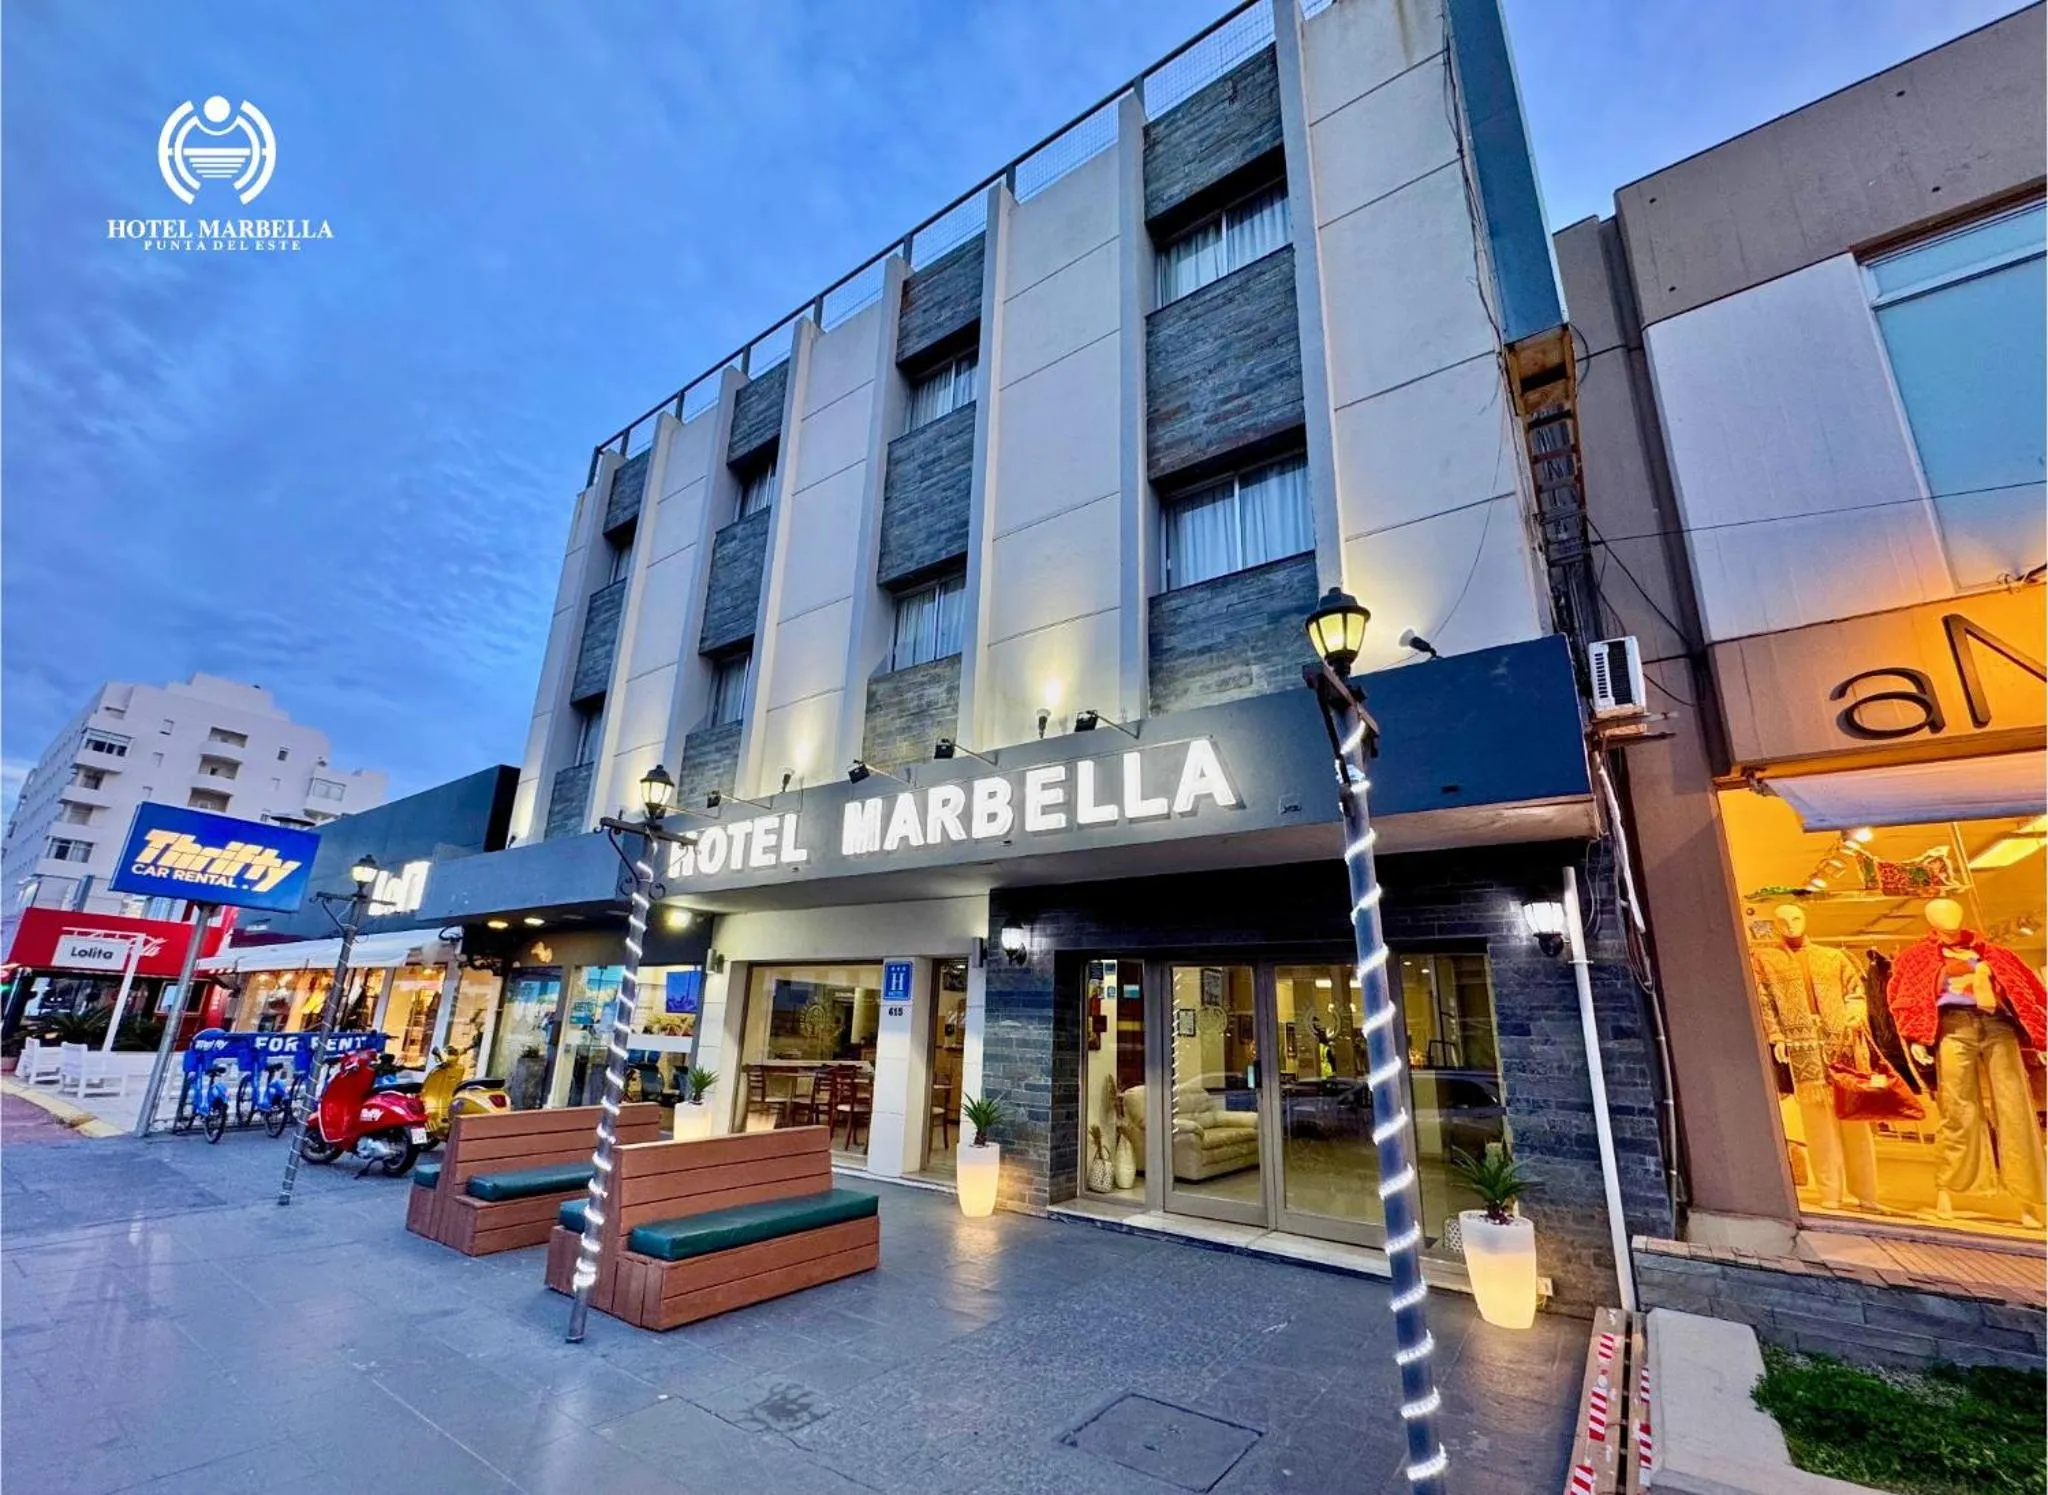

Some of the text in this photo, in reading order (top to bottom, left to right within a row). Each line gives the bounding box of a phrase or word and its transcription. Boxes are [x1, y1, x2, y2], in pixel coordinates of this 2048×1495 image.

[668, 738, 1236, 879] HOTEL MARBELLA
[134, 828, 302, 893] Thrifty
[131, 862, 237, 889] CAR RENTAL
[70, 946, 114, 961] Lolita
[891, 972, 905, 991] H
[888, 1007, 904, 1017] 615
[255, 1036, 299, 1052] FOR
